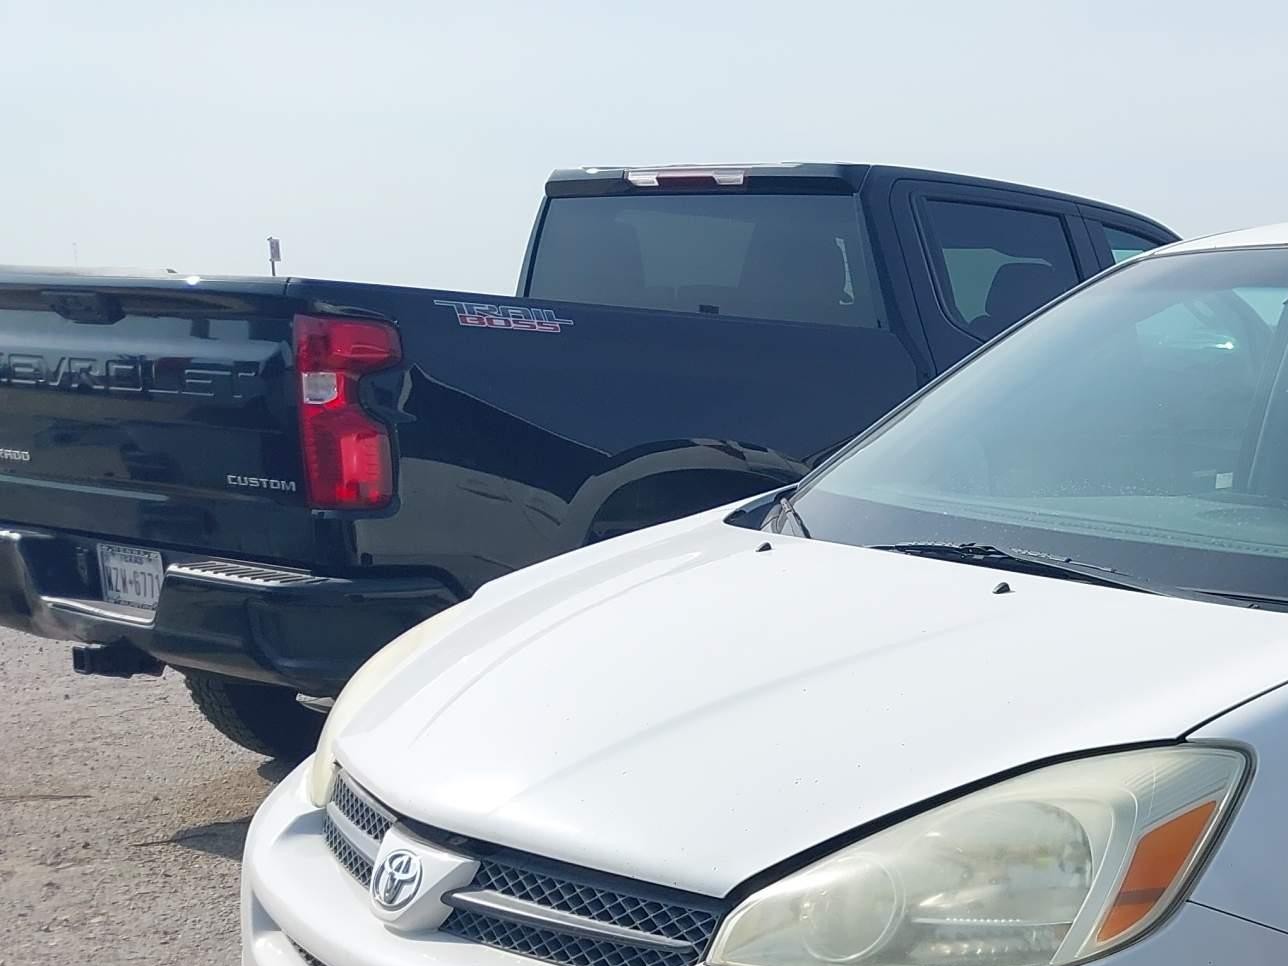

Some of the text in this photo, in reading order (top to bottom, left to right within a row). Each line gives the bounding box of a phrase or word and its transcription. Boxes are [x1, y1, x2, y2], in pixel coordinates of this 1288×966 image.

[433, 299, 574, 325] TRAIL
[458, 313, 561, 333] BOSS
[226, 474, 297, 492] CUSTOM
